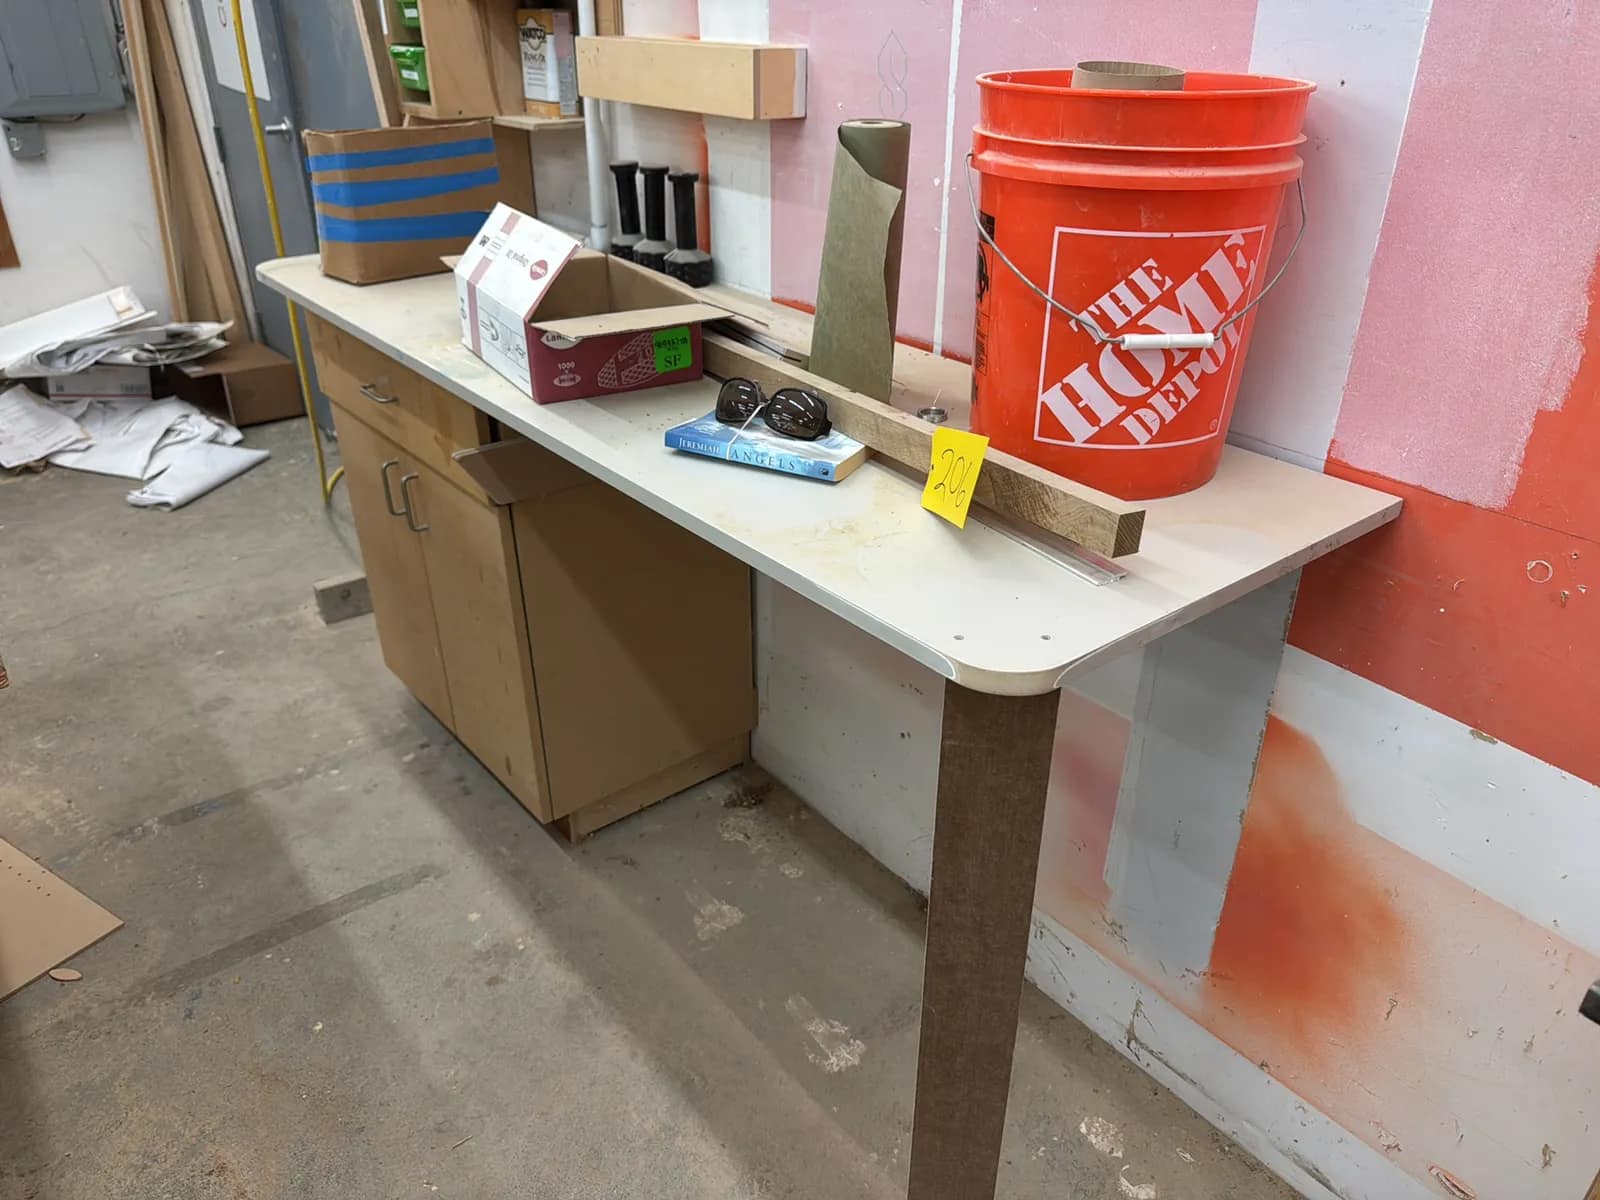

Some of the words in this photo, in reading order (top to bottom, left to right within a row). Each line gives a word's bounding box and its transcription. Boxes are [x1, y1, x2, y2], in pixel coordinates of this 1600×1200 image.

[1041, 232, 1256, 444] HOME
[1069, 258, 1174, 345] THE
[663, 353, 682, 368] SF
[1119, 311, 1240, 445] DEPOT
[678, 437, 720, 455] JEREMIAH
[731, 449, 796, 471] ANGELS
[933, 448, 973, 508] 206
